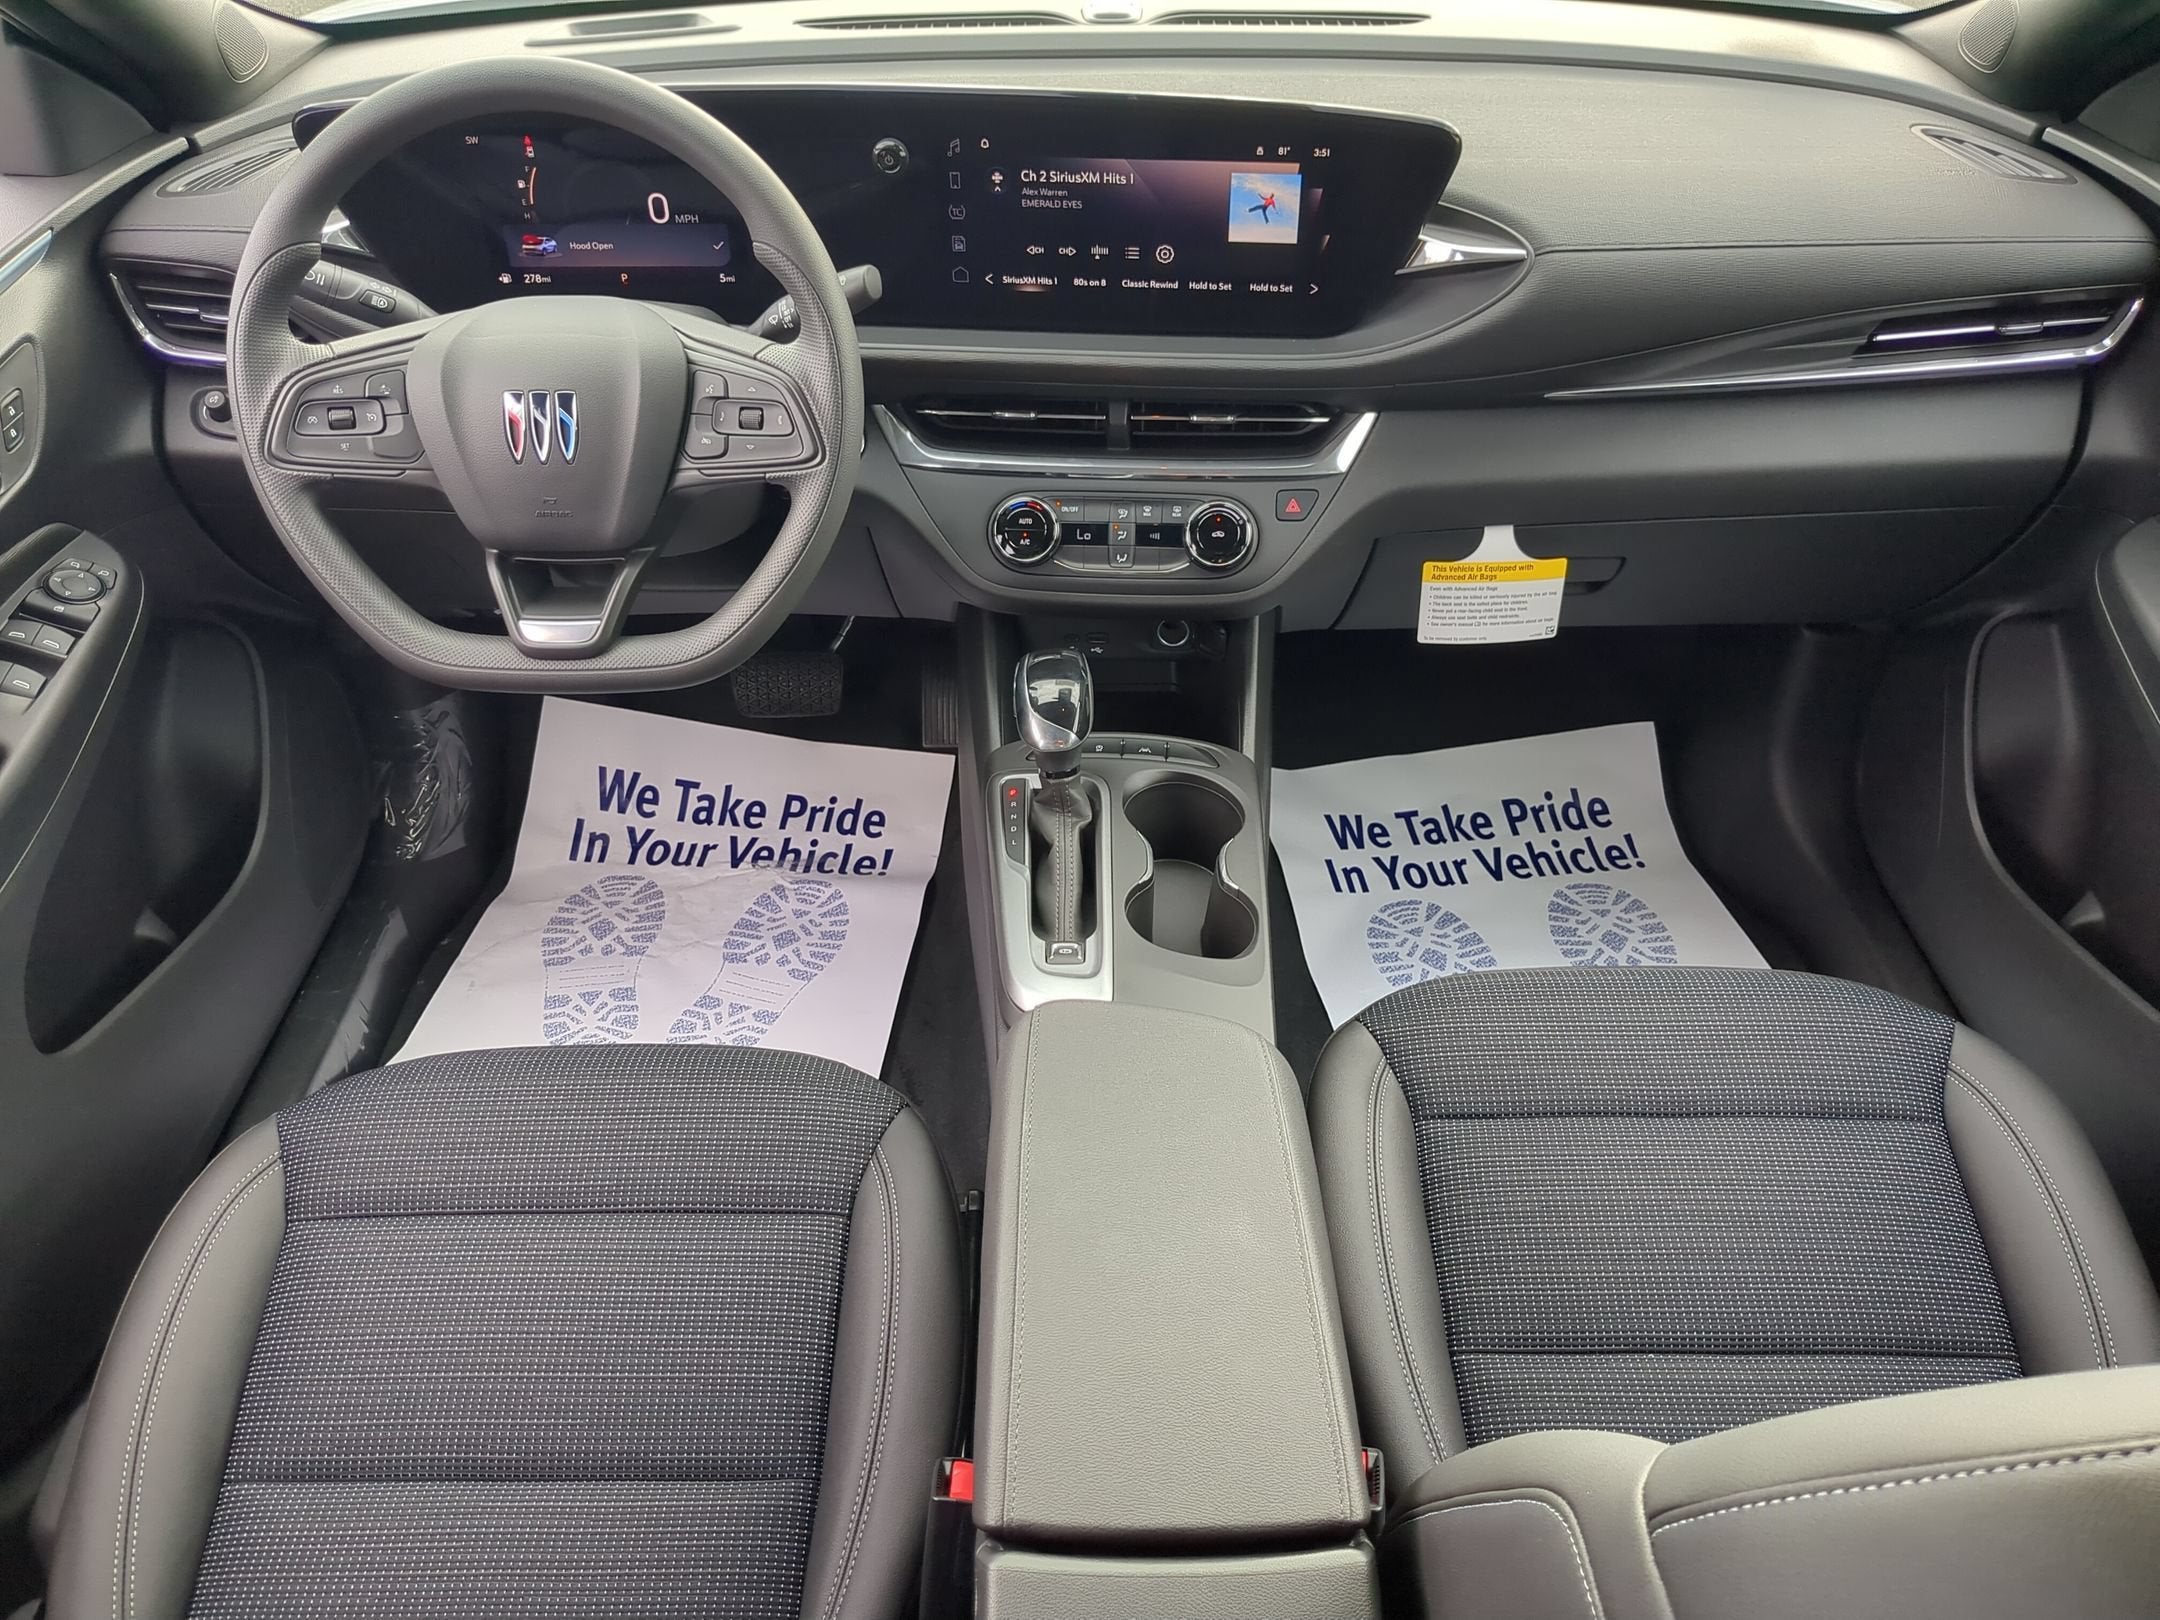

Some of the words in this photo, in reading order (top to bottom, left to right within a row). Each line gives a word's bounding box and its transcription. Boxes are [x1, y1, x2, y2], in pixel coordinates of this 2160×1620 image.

[465, 136, 479, 145] SW
[1313, 148, 1331, 157] 3:51
[1020, 170, 1037, 183] Ch
[1040, 171, 1047, 183] 2
[1049, 171, 1100, 184] SiriusXM
[1103, 174, 1127, 185] Hits
[1021, 187, 1038, 197] Alex
[1039, 188, 1068, 198] Warren
[647, 192, 670, 224] 0
[675, 214, 699, 224] MPH
[1021, 199, 1060, 209] EMERALD
[1062, 200, 1083, 210] EYES
[952, 208, 962, 217] TC
[569, 241, 591, 250] Hood
[592, 241, 614, 251] Open
[621, 274, 628, 284] P
[1002, 276, 1036, 286] SiriusXM
[1037, 277, 1052, 286] Hits
[1073, 278, 1087, 287] 80s
[1100, 279, 1107, 287] 8
[1121, 279, 1148, 289] Classic
[1150, 280, 1179, 290] Rewind
[1189, 281, 1207, 291] Hold
[1208, 282, 1217, 291] to
[1219, 282, 1232, 291] Set
[1249, 283, 1268, 293] Hold
[1269, 284, 1277, 293] to
[1280, 284, 1293, 293] Set
[1432, 565, 1447, 573] This
[1449, 565, 1474, 573] Vehicle
[1484, 564, 1517, 573] Equipped
[1519, 563, 1534, 571] with
[1431, 573, 1466, 581] Advanced
[1479, 573, 1497, 581] Bags
[598, 765, 660, 819] We
[674, 778, 767, 829] Take
[778, 793, 887, 839] Pride
[1323, 813, 1392, 850] We
[1394, 803, 1496, 846] Take
[1501, 787, 1613, 836] Pride
[568, 818, 611, 863] In
[626, 825, 719, 869] Your
[729, 835, 894, 876] Vehicle!
[1324, 858, 1370, 893] In
[1371, 854, 1468, 890] Your
[1472, 833, 1646, 882] Vehicle!
